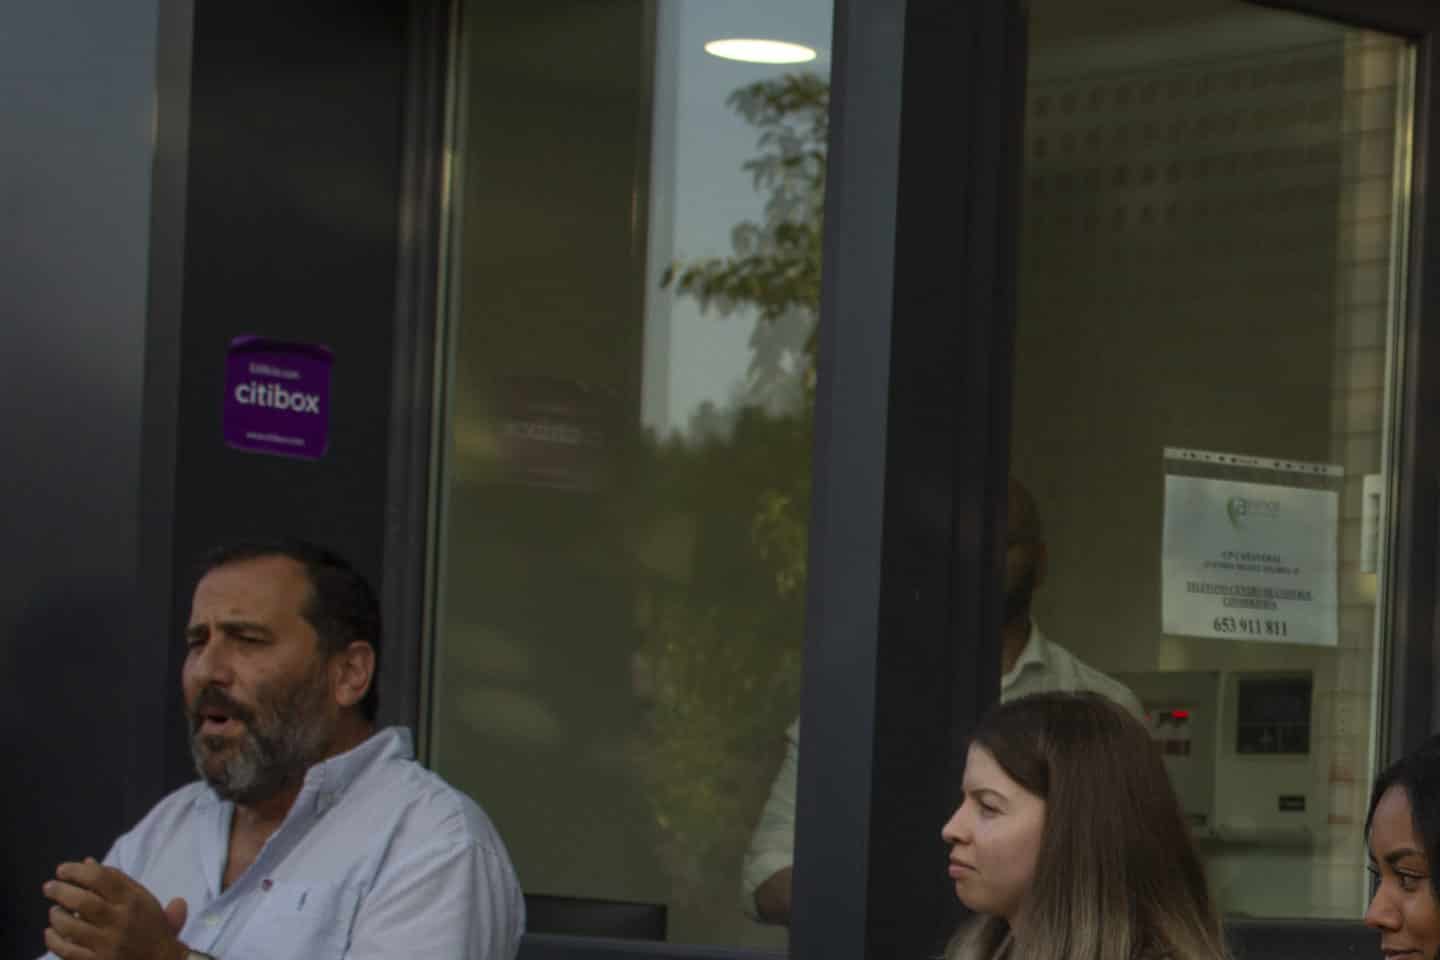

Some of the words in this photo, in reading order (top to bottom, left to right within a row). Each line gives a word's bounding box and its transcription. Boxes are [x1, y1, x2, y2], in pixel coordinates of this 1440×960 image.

[235, 381, 319, 414] citibox
[1214, 617, 1236, 633] 653
[1239, 618, 1262, 634] 911
